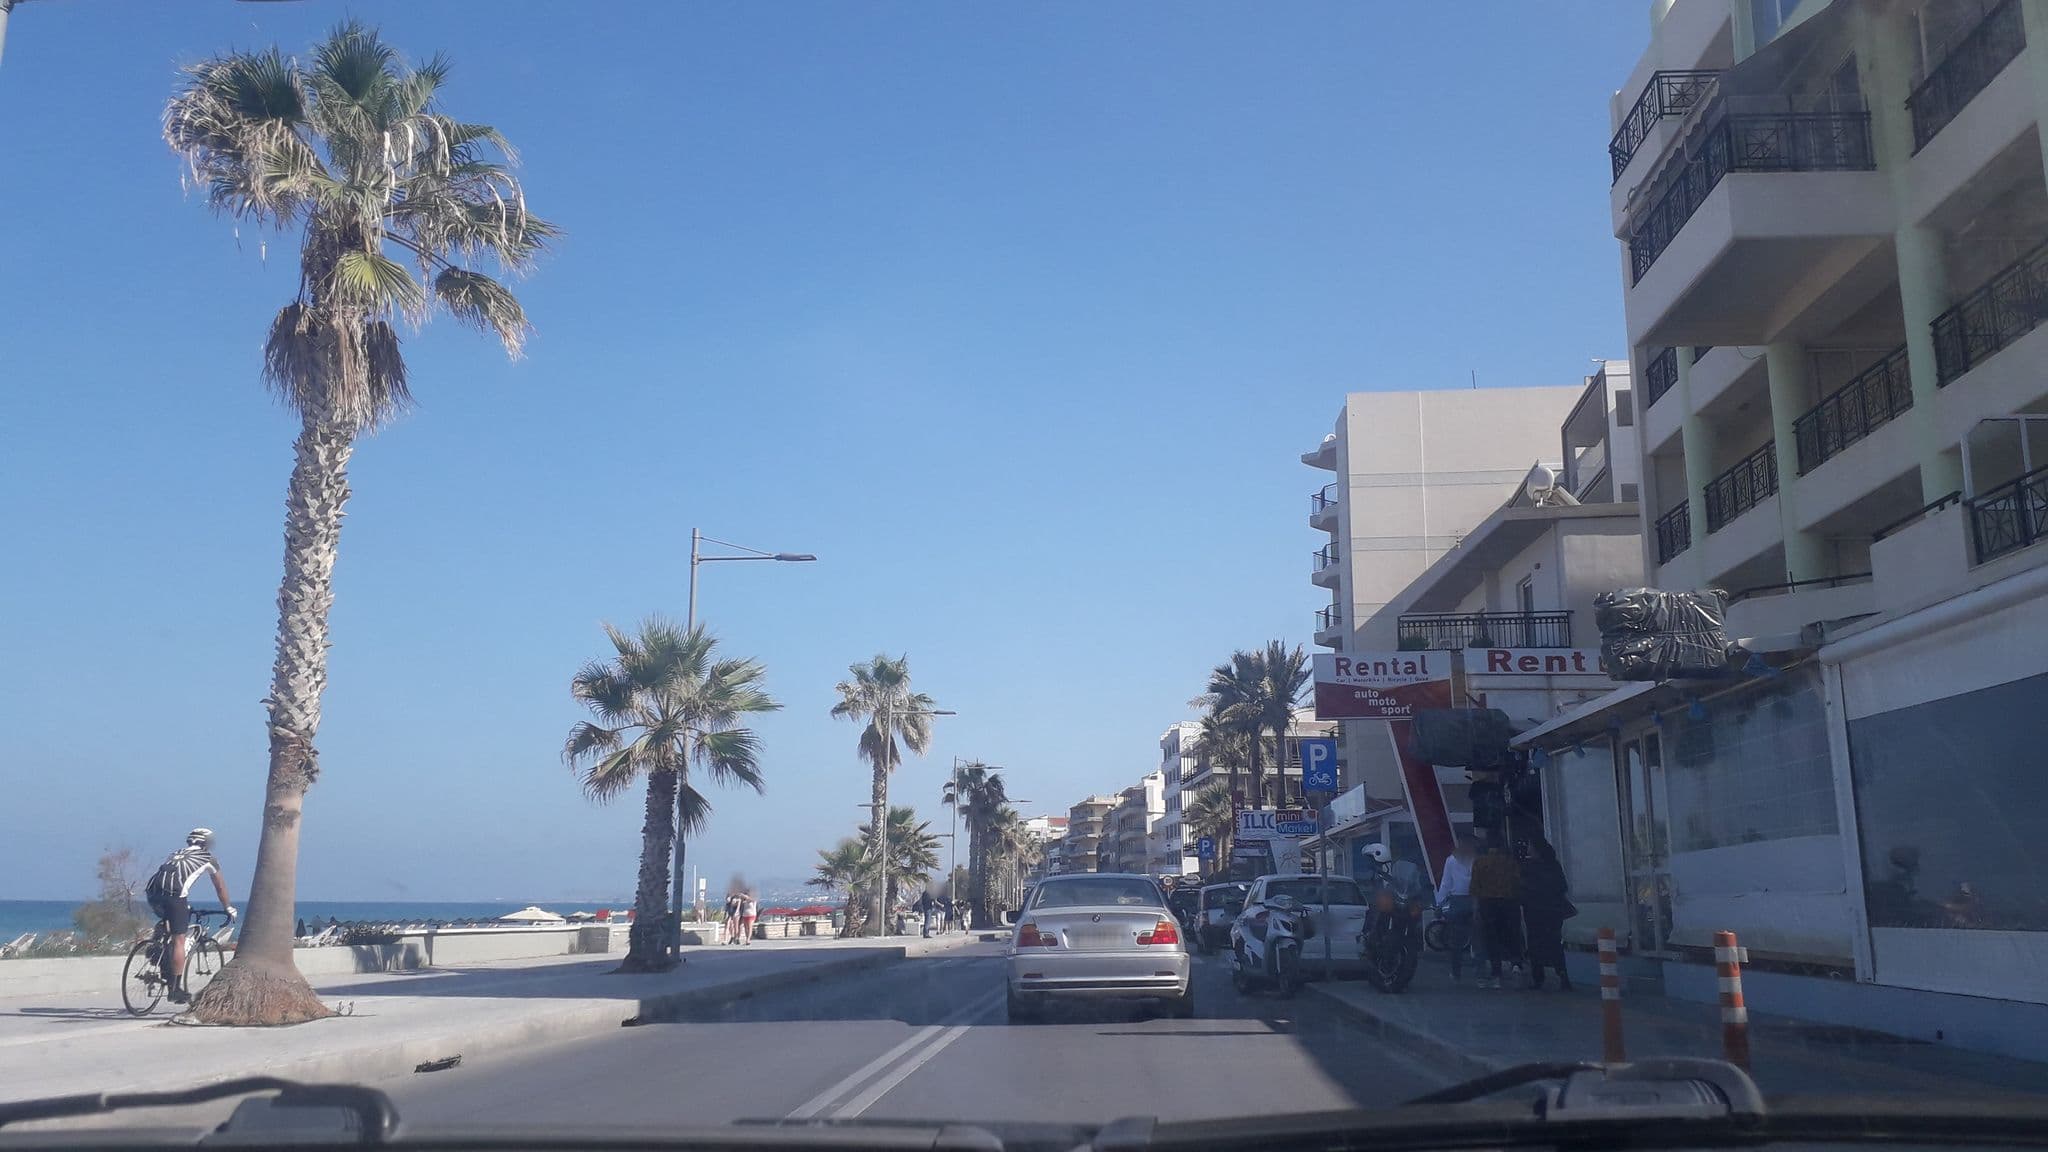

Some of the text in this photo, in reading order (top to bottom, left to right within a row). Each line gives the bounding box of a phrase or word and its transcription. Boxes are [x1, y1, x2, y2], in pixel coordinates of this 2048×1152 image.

[1335, 654, 1429, 677] Rental
[1487, 649, 1586, 673] Rent
[1354, 689, 1379, 699] auto
[1368, 696, 1397, 706] moto
[1380, 704, 1410, 716] sport
[1310, 744, 1328, 771] P
[1277, 812, 1300, 822] mini
[1278, 823, 1314, 833] Market
[1202, 839, 1211, 852] P
